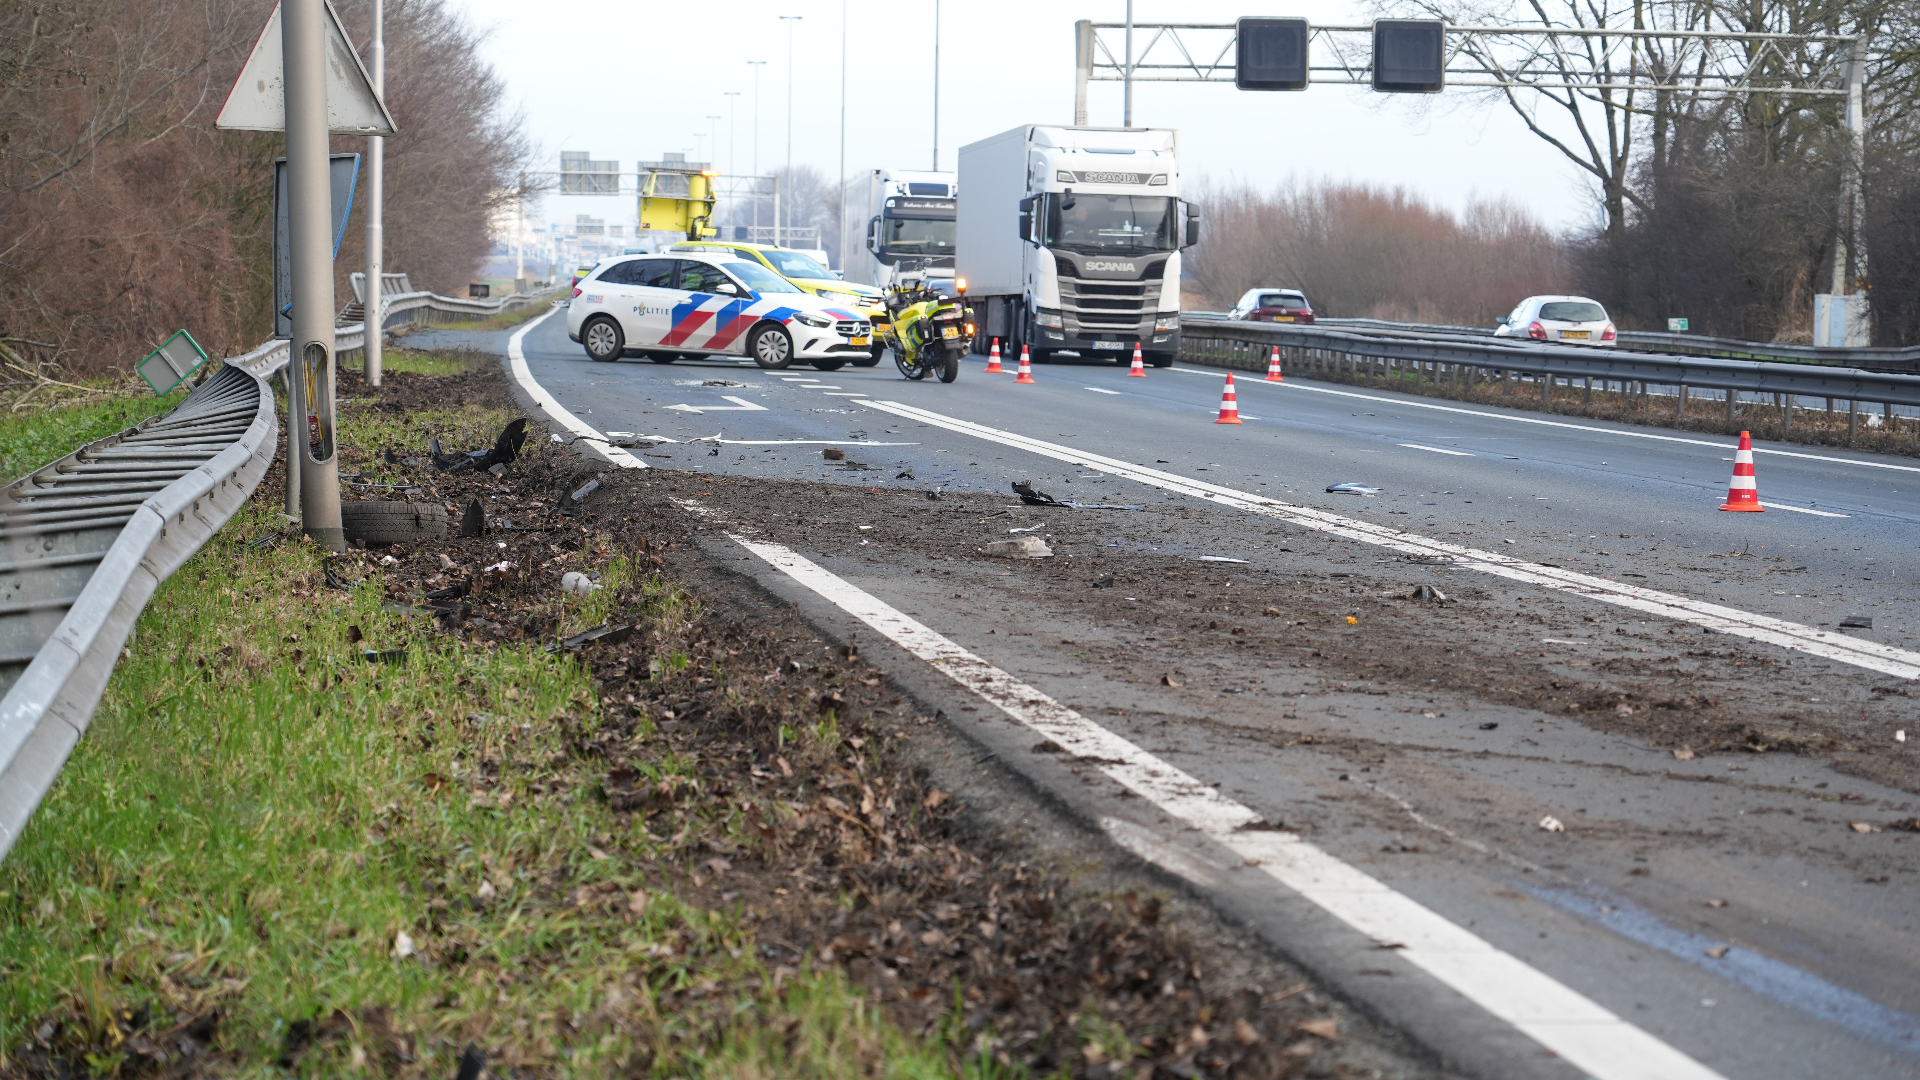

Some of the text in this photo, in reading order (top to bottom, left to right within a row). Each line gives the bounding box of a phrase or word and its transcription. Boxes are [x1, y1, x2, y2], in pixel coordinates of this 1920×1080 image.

[1085, 172, 1140, 184] SCANIA
[1085, 261, 1136, 272] SCANIA
[633, 306, 670, 316] POLITIE
